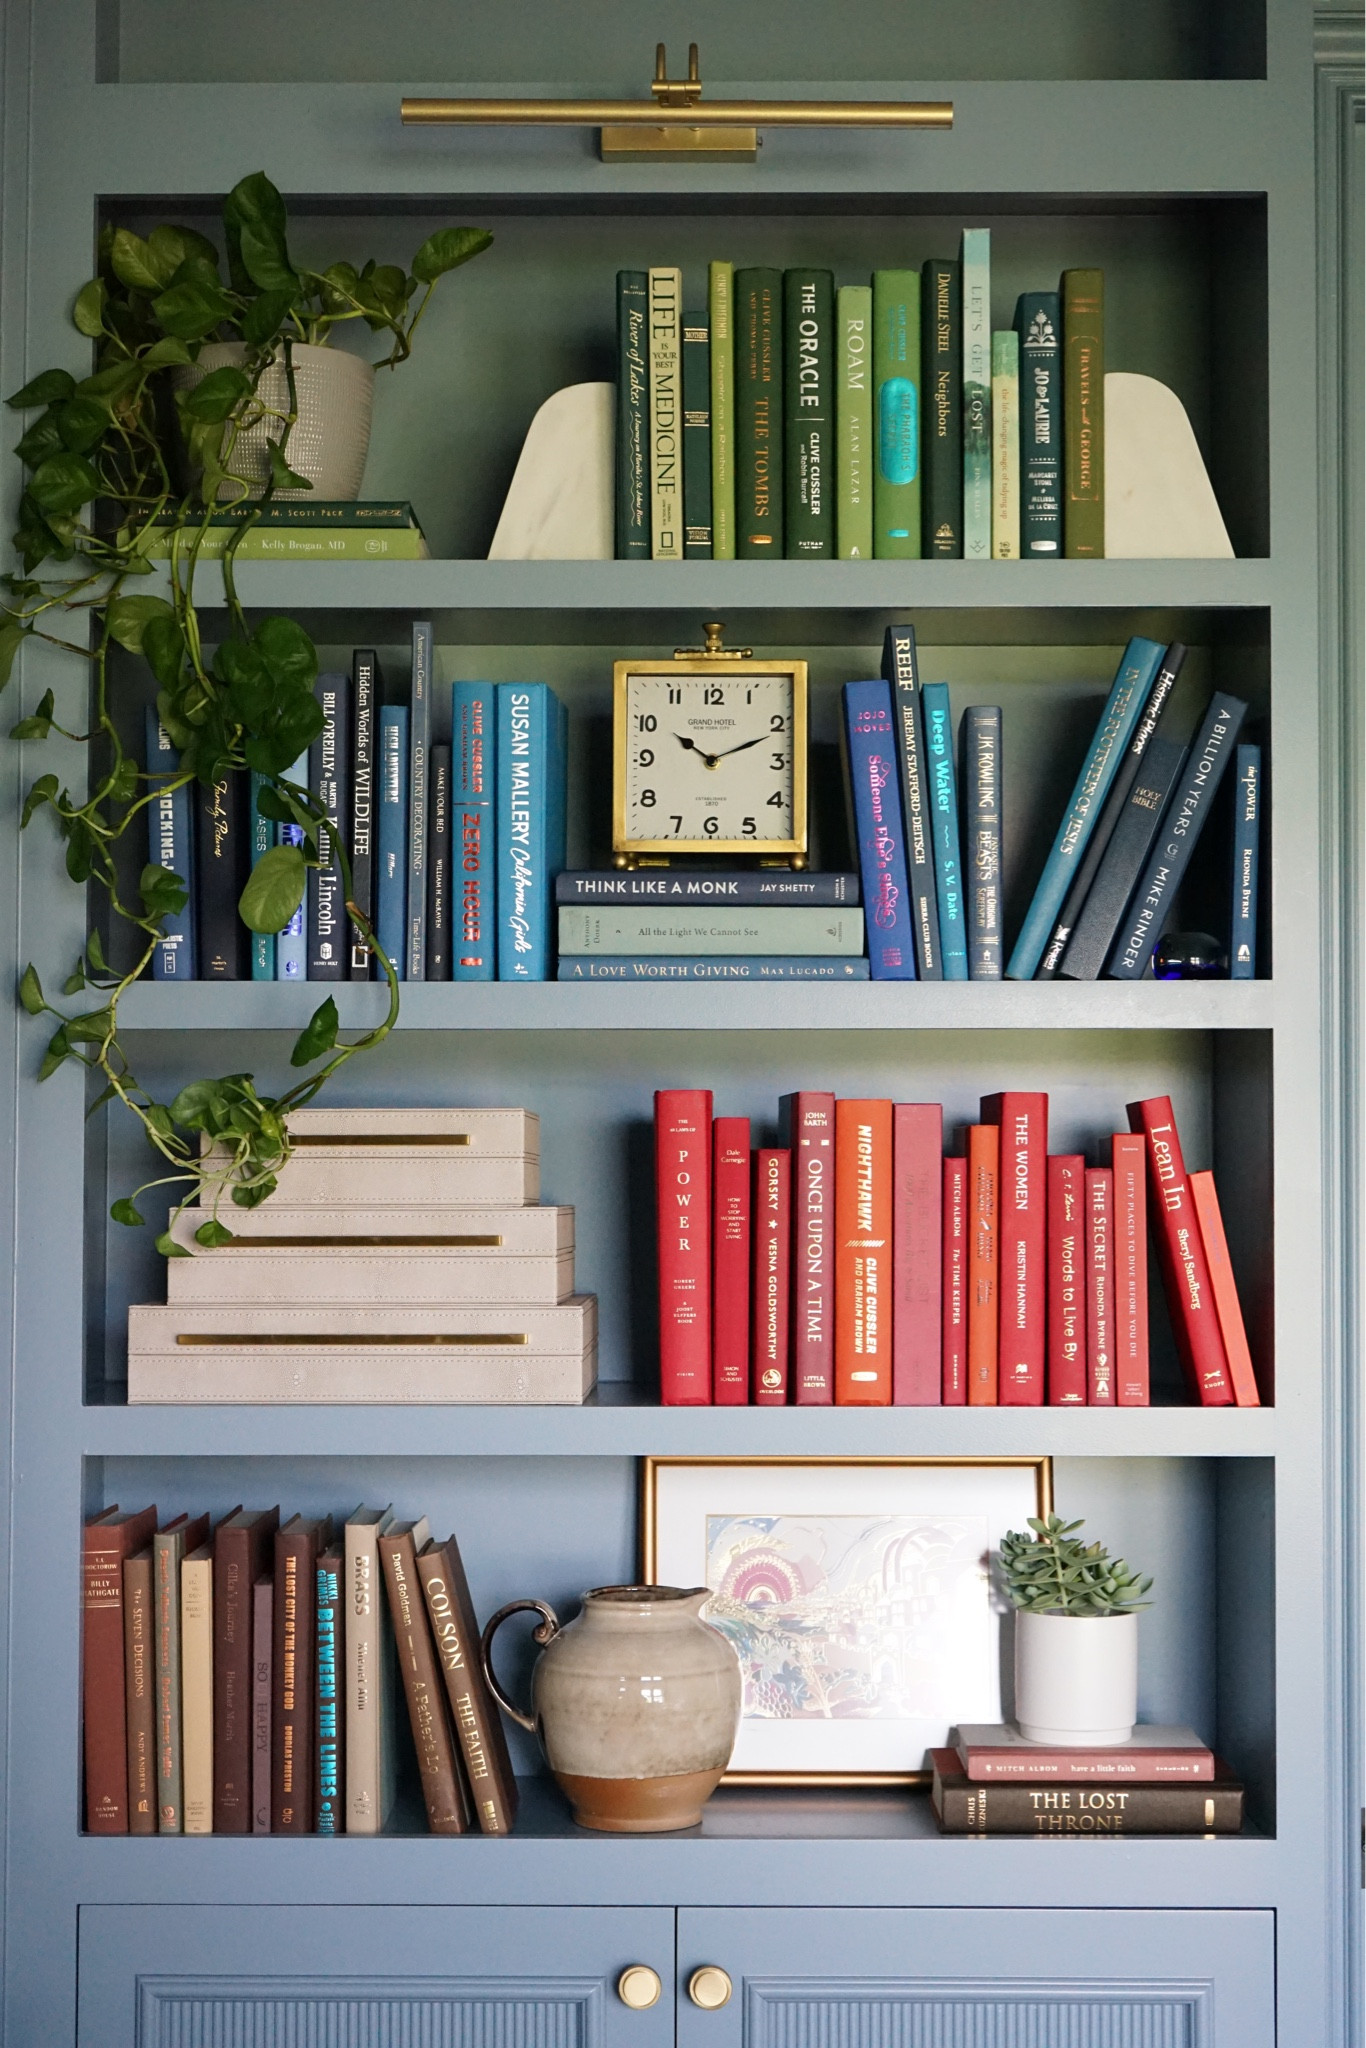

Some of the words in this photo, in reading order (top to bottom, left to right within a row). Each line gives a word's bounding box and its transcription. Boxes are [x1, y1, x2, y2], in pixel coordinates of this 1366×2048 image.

[652, 274, 676, 340] LIFE
[801, 284, 816, 314] THE
[937, 272, 951, 321] DANIELLE
[971, 285, 983, 332] LET'S
[661, 342, 669, 350] IS
[685, 331, 708, 339] MOTHER
[937, 323, 950, 354] STEEL
[655, 361, 674, 369] BEST
[799, 319, 819, 407] ORACLE
[847, 319, 865, 390] ROAM
[971, 344, 983, 377] GET
[755, 397, 769, 440] THE
[934, 371, 951, 437] Neighbors
[971, 389, 984, 433] LOST
[655, 373, 676, 495] MEDICINE
[810, 432, 821, 463] CLIVE
[851, 416, 859, 453] ALAN
[755, 446, 770, 517] TOMBS
[801, 455, 809, 477] Robin
[851, 461, 860, 504] LAZAR
[801, 478, 809, 504] Burcell
[810, 466, 821, 515] CUSSLER
[271, 509, 283, 517] M.
[288, 509, 316, 517] SCOTT
[321, 509, 344, 517] PECK
[895, 637, 914, 691] REEF
[669, 688, 681, 704] 11
[704, 688, 725, 705] 12
[472, 701, 482, 736] CLIVE
[511, 694, 529, 755] SUSAN
[639, 714, 658, 732] 10
[687, 718, 713, 726] GRAND
[713, 718, 736, 726] HOTEL
[770, 715, 785, 732] 2
[854, 723, 891, 732] MOYES
[1219, 708, 1231, 720] A
[929, 710, 946, 755] Deep
[471, 739, 482, 793] CUSSLER
[639, 749, 655, 767] 9
[769, 753, 785, 770] 3
[1193, 723, 1227, 786] BILLION
[413, 747, 424, 799] COUNTRY
[436, 767, 444, 790] MAKE
[935, 759, 951, 813] Water
[329, 782, 337, 808] MARTIN
[436, 792, 444, 813] YOUR
[511, 761, 529, 845] MALLERY
[640, 789, 657, 807] 8
[766, 791, 784, 808] 4
[669, 816, 683, 833] 7
[703, 817, 719, 834] 6
[742, 817, 757, 834] 5
[1172, 789, 1203, 837] YEARS
[412, 801, 423, 870] DECORATING
[463, 812, 480, 872] ZERO
[1242, 848, 1253, 887] RHONDA
[575, 881, 627, 893] THINK
[632, 881, 667, 893] LIKE
[670, 881, 683, 893] A
[686, 881, 739, 894] MONK
[760, 884, 778, 892] JAY
[779, 884, 816, 892] SHETTY
[1145, 866, 1171, 905] MIKE
[318, 876, 338, 936] Lincoln
[463, 880, 480, 942] HOUR
[921, 896, 929, 916] SIERRA
[1241, 888, 1252, 919] BYRNE
[412, 916, 421, 951] Time-Life
[638, 928, 651, 936] All
[653, 928, 667, 936] the
[669, 927, 692, 938] Light
[710, 928, 741, 936] Cannot
[743, 928, 759, 936] See
[922, 916, 930, 935] CLUB
[1121, 908, 1154, 969] RINDER
[412, 954, 421, 975] Books
[923, 936, 932, 968] BOOKS
[573, 965, 583, 976] A
[590, 964, 627, 976] LOVE
[633, 964, 688, 976] WORTH
[693, 964, 750, 976] GIVING
[761, 967, 784, 975] MAX
[790, 966, 835, 975] LUCADO
[1015, 1113, 1028, 1146] THE
[720, 1156, 746, 1164] Carnegie
[1150, 1123, 1178, 1181] Lean
[767, 1158, 779, 1210] GORSKY
[806, 1159, 823, 1213] ONCE
[857, 1124, 873, 1231] NIGHTHAWK
[953, 1173, 961, 1203] MITCH
[1015, 1150, 1028, 1210] WOMEN
[1127, 1172, 1135, 1199] FIFTY
[1093, 1181, 1106, 1211] THE
[1162, 1184, 1186, 1212] In
[953, 1205, 961, 1237] ALBOM
[1127, 1202, 1135, 1236] PLACES
[767, 1237, 778, 1272] VESNA
[807, 1219, 823, 1274] UPON
[952, 1249, 961, 1262] The
[1062, 1236, 1075, 1284] Words
[1093, 1216, 1107, 1271] SECRET
[1127, 1239, 1135, 1253] TO
[1176, 1228, 1194, 1261] Sheryl
[866, 1257, 877, 1295] CLIVE
[952, 1265, 960, 1287] TIME
[1016, 1240, 1026, 1281] KRISTIN
[1127, 1255, 1136, 1278] DIVE
[807, 1279, 821, 1292] A
[1062, 1287, 1073, 1302] to
[1128, 1280, 1136, 1315] BEFORE
[1184, 1262, 1202, 1310] Sandberg
[767, 1275, 777, 1360] GOLDSWORTHY
[806, 1296, 822, 1343] TIME
[952, 1290, 960, 1325] KEEPER
[1016, 1283, 1025, 1329] HANNAH
[1062, 1306, 1075, 1337] Live
[866, 1296, 877, 1354] CUSSLER
[1128, 1319, 1137, 1339] YOU
[1061, 1342, 1077, 1362] By
[1128, 1342, 1137, 1358] DIE
[391, 1552, 408, 1581] David
[327, 1572, 338, 1600] NIKKI
[355, 1555, 370, 1616] BRASS
[395, 1582, 412, 1627] Goldman
[426, 1577, 465, 1671] COLSON
[317, 1607, 335, 1698] BETWEEN
[319, 1702, 336, 1738] THE
[456, 1692, 476, 1729] THE
[320, 1743, 337, 1796] LINES
[464, 1729, 489, 1780] FAITH
[1071, 1764, 1088, 1772] have
[1096, 1764, 1116, 1772] little
[1117, 1764, 1136, 1772] faith
[967, 1797, 976, 1825] CHRIS
[1029, 1792, 1071, 1809] THE
[1079, 1793, 1129, 1809] LOST
[1035, 1815, 1123, 1830] THRONE
